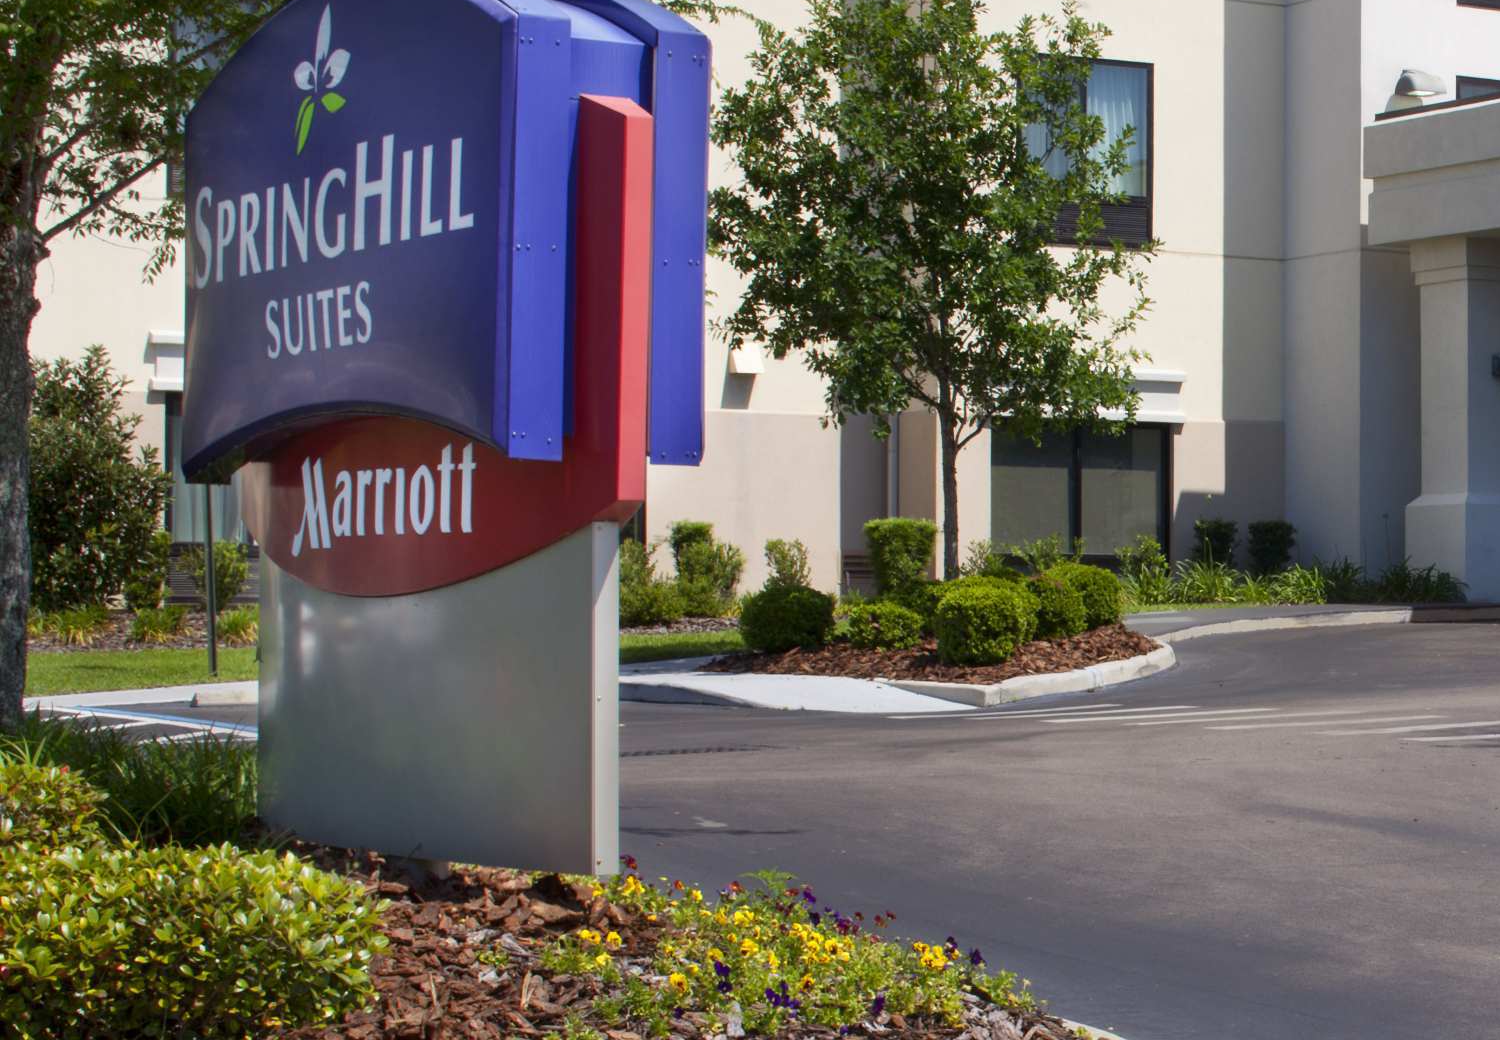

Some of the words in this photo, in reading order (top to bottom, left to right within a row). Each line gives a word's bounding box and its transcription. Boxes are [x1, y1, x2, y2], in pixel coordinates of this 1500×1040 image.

[195, 134, 474, 289] SPRINGHILL
[266, 282, 372, 359] SUITES
[291, 442, 477, 556] Marriott
